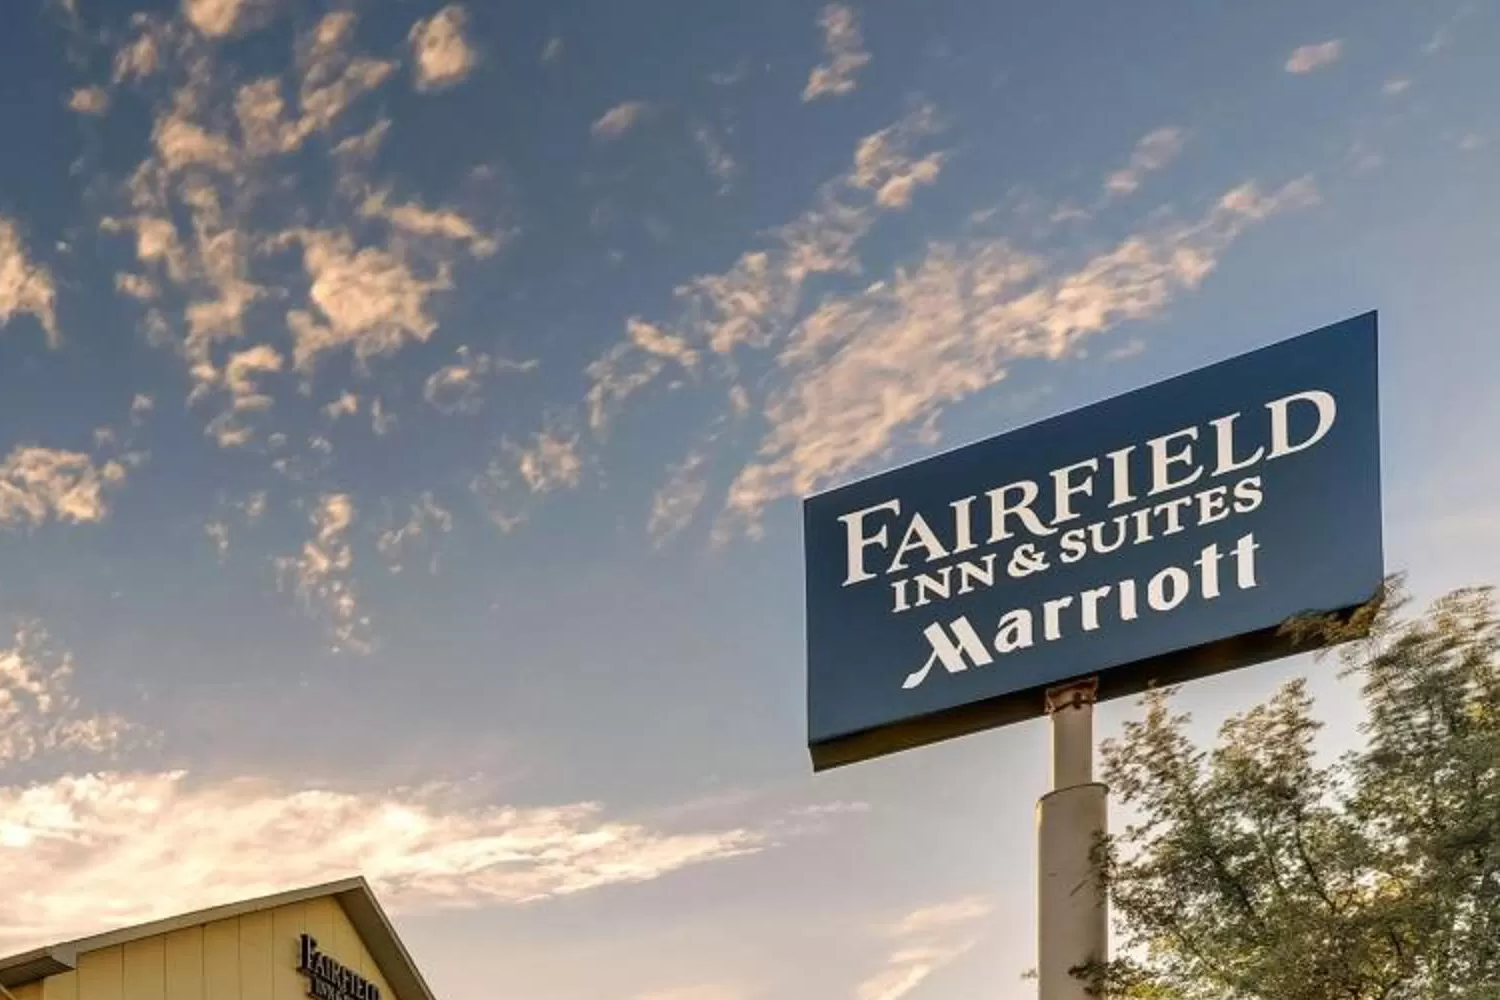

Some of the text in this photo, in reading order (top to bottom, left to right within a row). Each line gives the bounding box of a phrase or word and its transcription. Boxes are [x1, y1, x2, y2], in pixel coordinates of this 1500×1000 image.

[838, 390, 1337, 588] FAIRFIELD
[891, 475, 1265, 613] INN & SUITES
[901, 531, 1262, 689] Marriott
